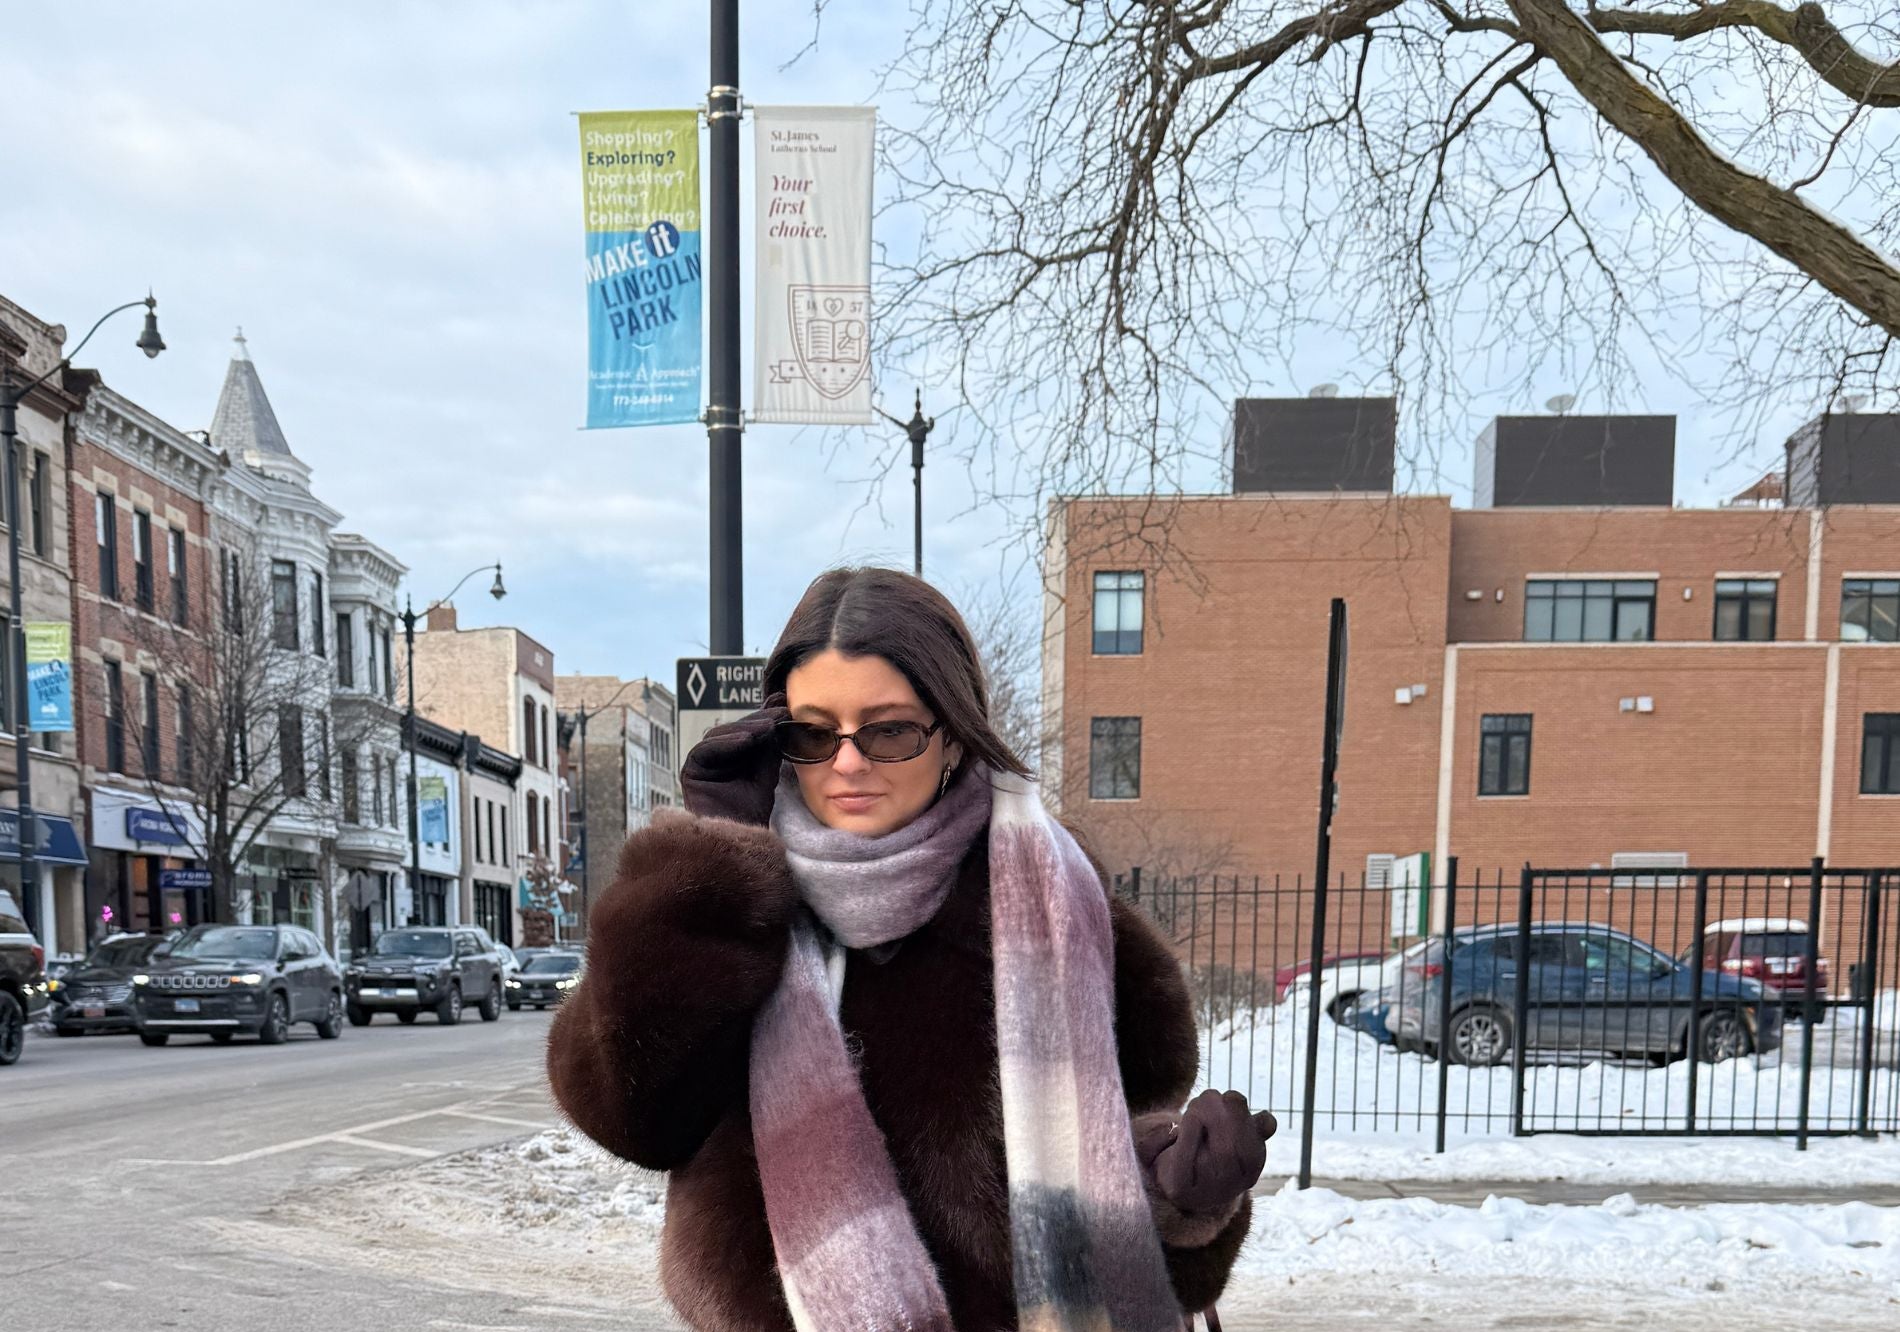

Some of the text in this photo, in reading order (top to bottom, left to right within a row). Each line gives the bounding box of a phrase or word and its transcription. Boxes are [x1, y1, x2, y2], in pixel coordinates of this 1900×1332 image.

[585, 128, 674, 148] Shopping?
[587, 150, 676, 168] Exploring?
[588, 170, 685, 190] Upgrading?
[772, 174, 814, 192] Your
[768, 197, 805, 218] first
[769, 220, 827, 239] choice.
[585, 223, 676, 285] MAKE it
[600, 252, 702, 310] LINCOLN
[608, 294, 678, 341] PARK
[716, 666, 764, 682] RIGHT
[718, 687, 763, 703] LANE
